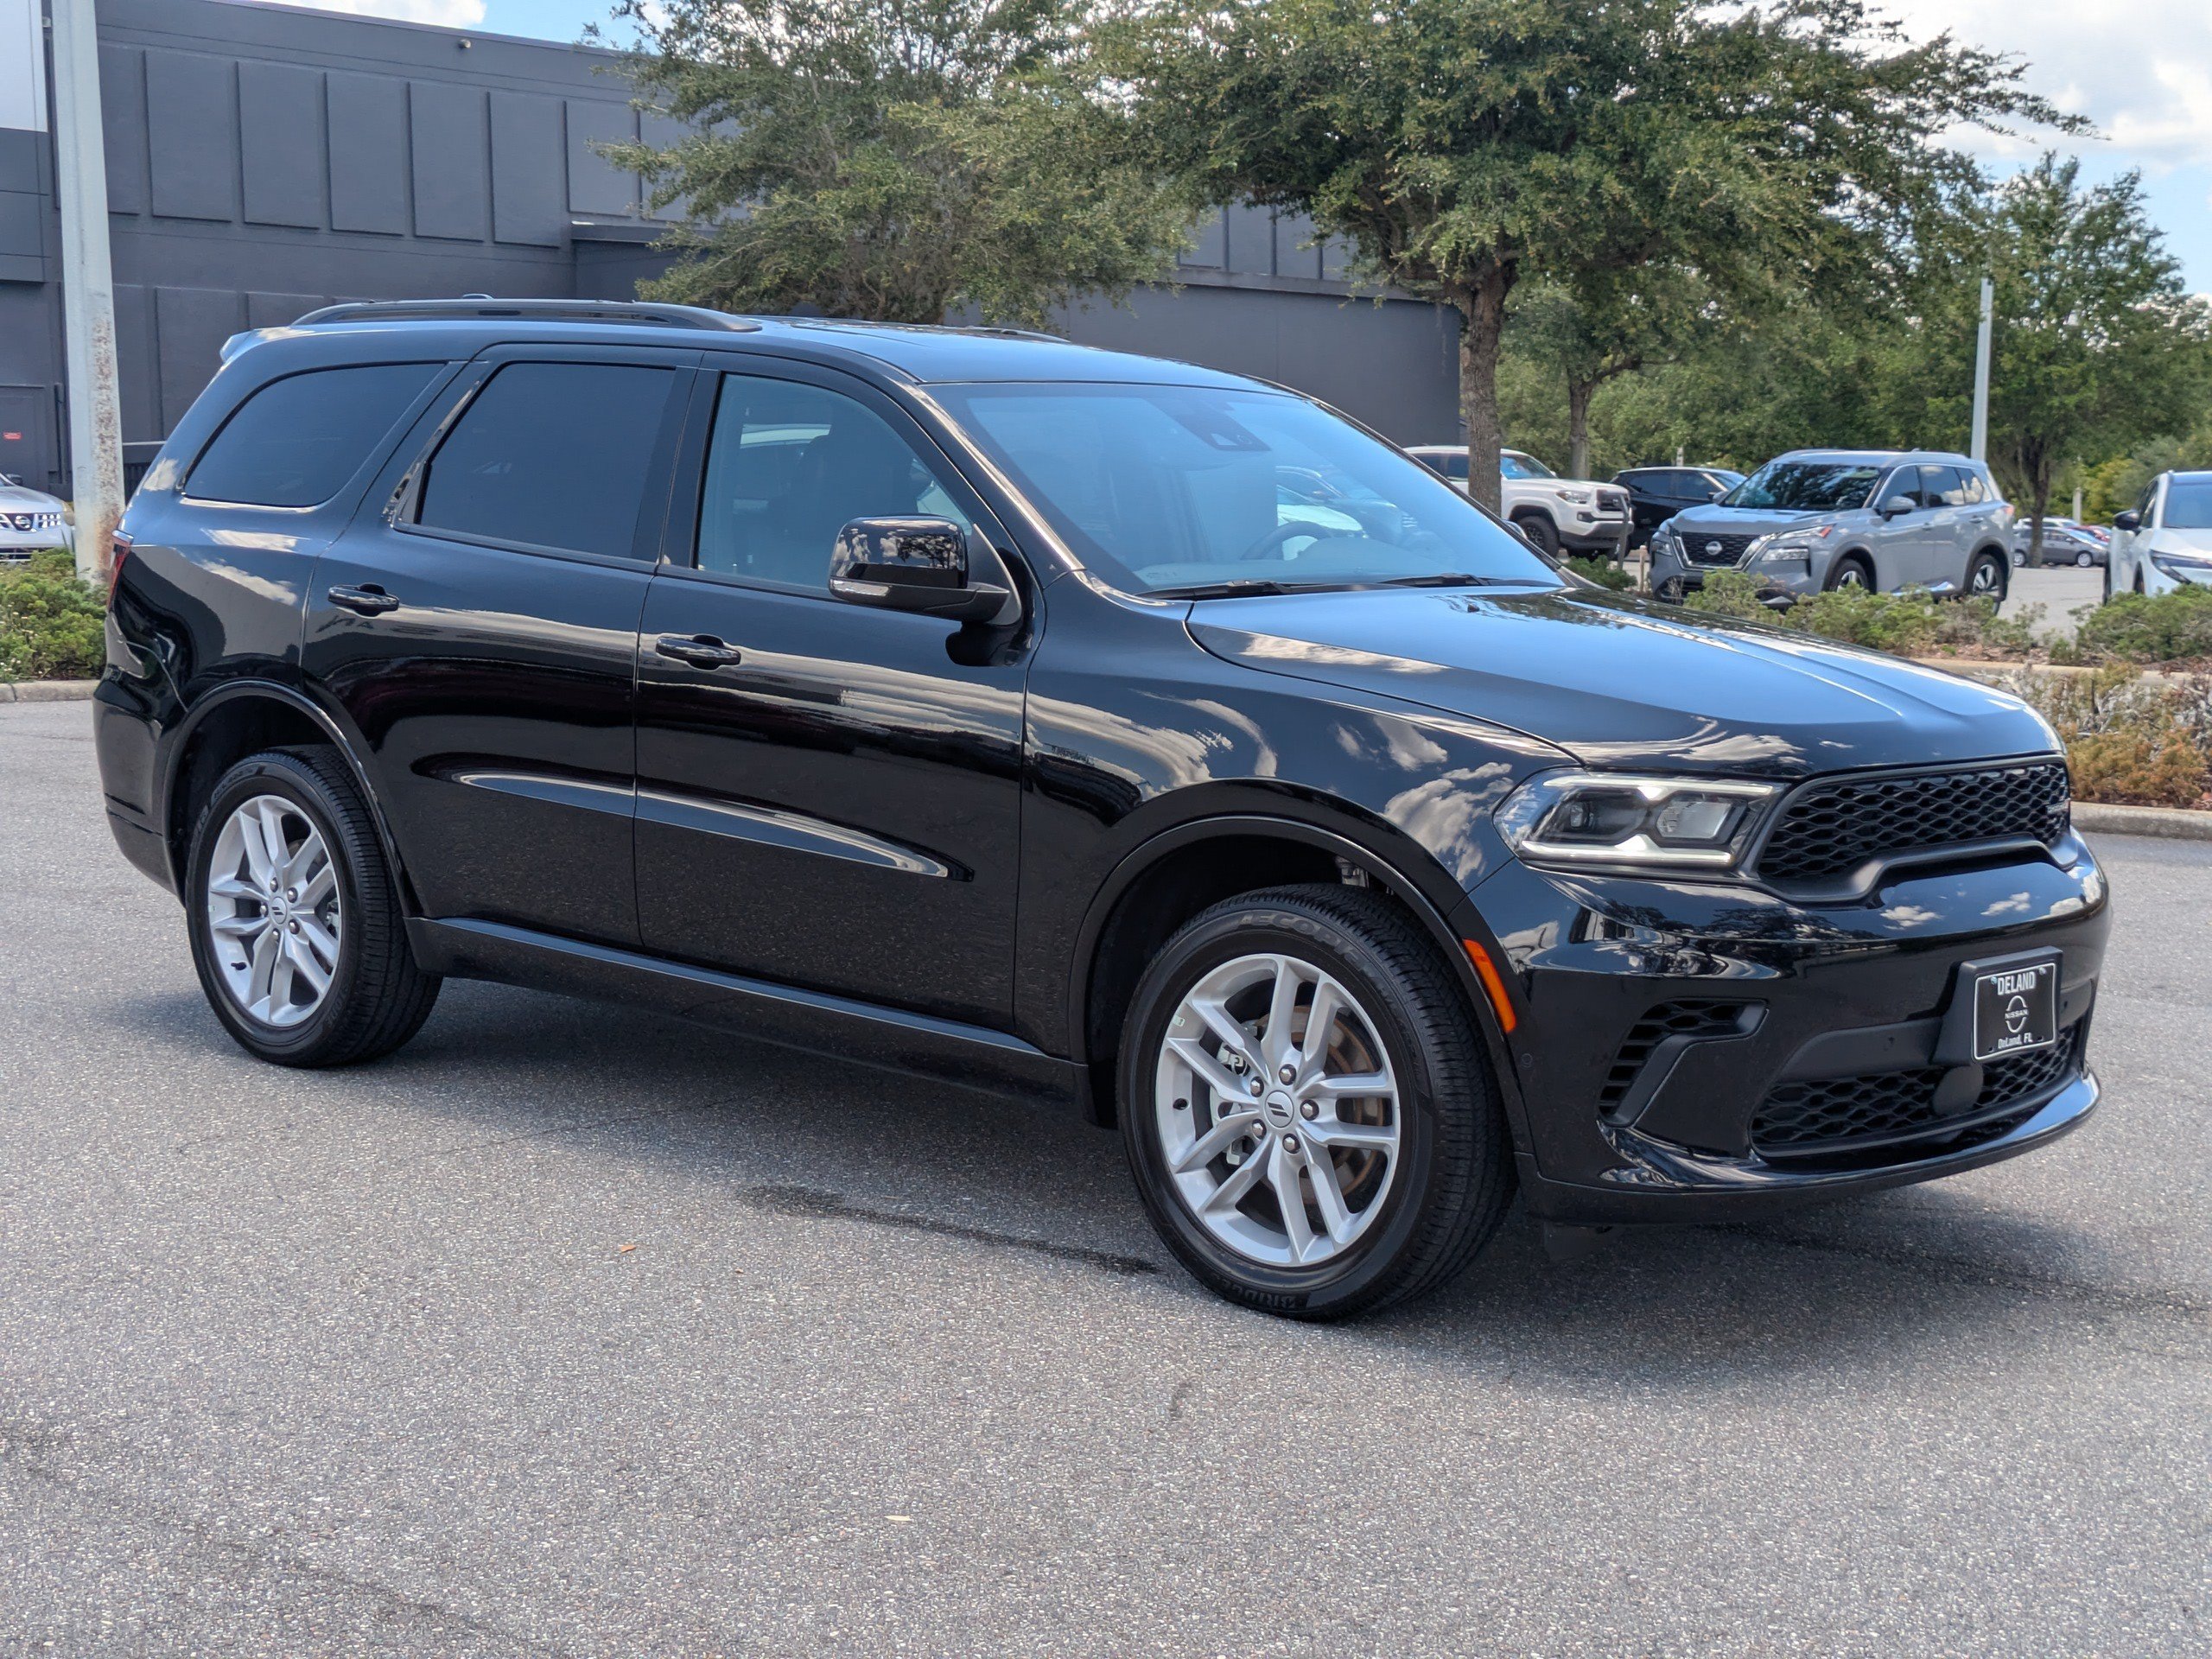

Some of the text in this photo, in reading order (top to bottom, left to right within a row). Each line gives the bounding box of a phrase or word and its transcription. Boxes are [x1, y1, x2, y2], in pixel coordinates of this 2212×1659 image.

[1998, 972, 2036, 995] DELAND
[2005, 1010, 2028, 1019] NISSAN
[2024, 1033, 2033, 1043] FL
